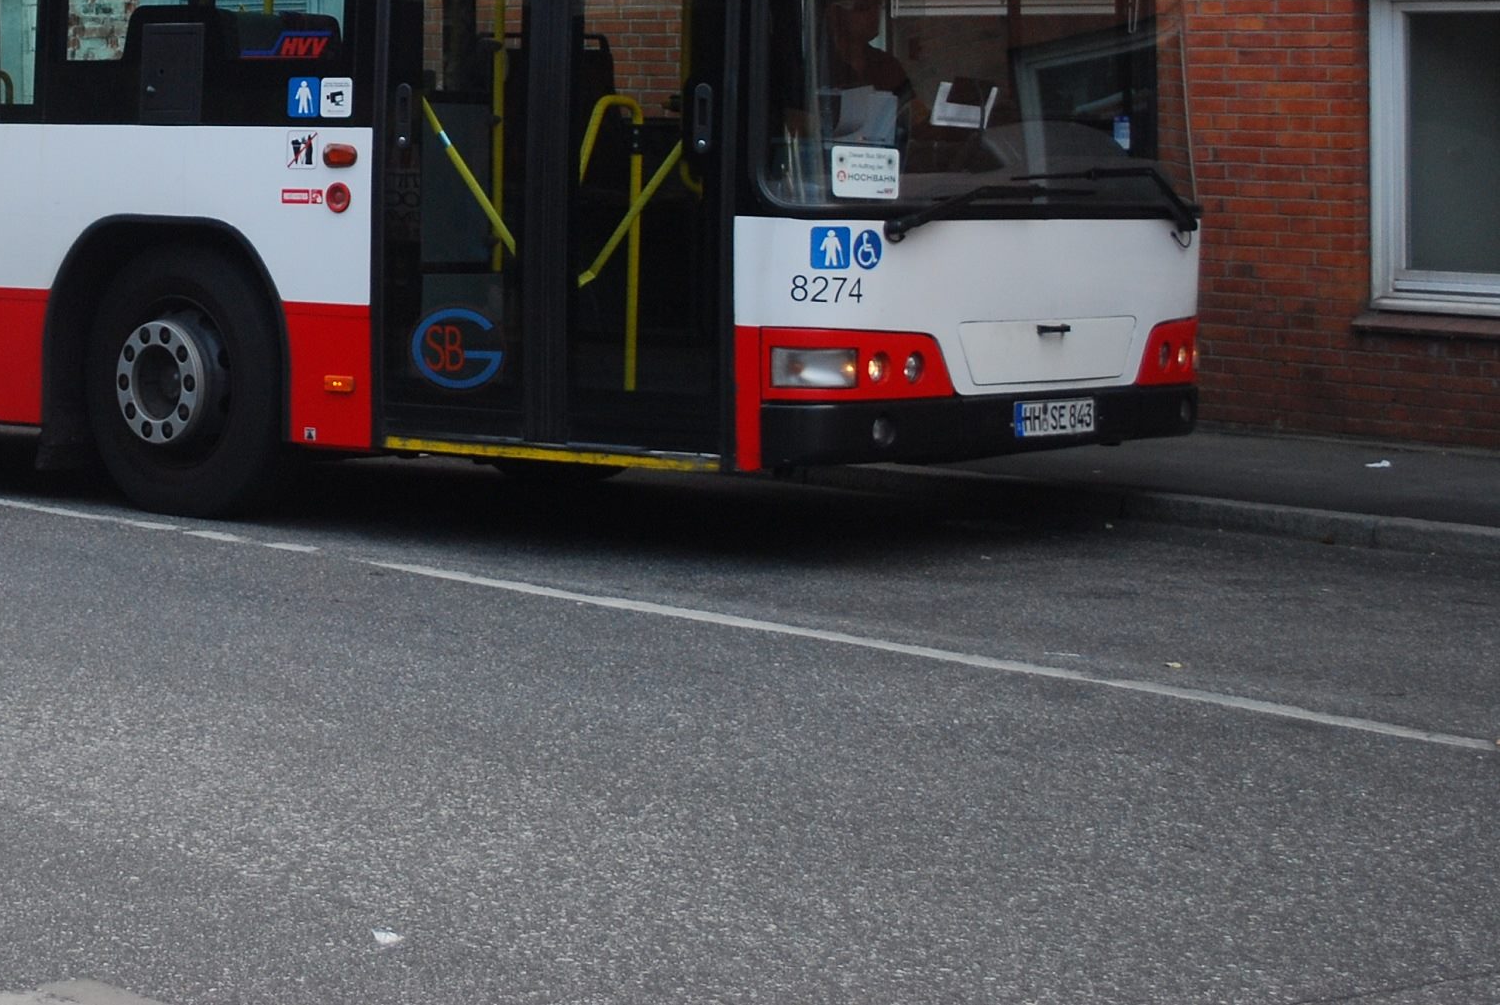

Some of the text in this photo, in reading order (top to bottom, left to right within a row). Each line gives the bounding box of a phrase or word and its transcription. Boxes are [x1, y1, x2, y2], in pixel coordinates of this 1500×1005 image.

[281, 36, 329, 58] HVV
[848, 172, 896, 183] HOCHBAHN
[790, 275, 863, 304] 8274
[1023, 402, 1092, 432] HH SE 843
